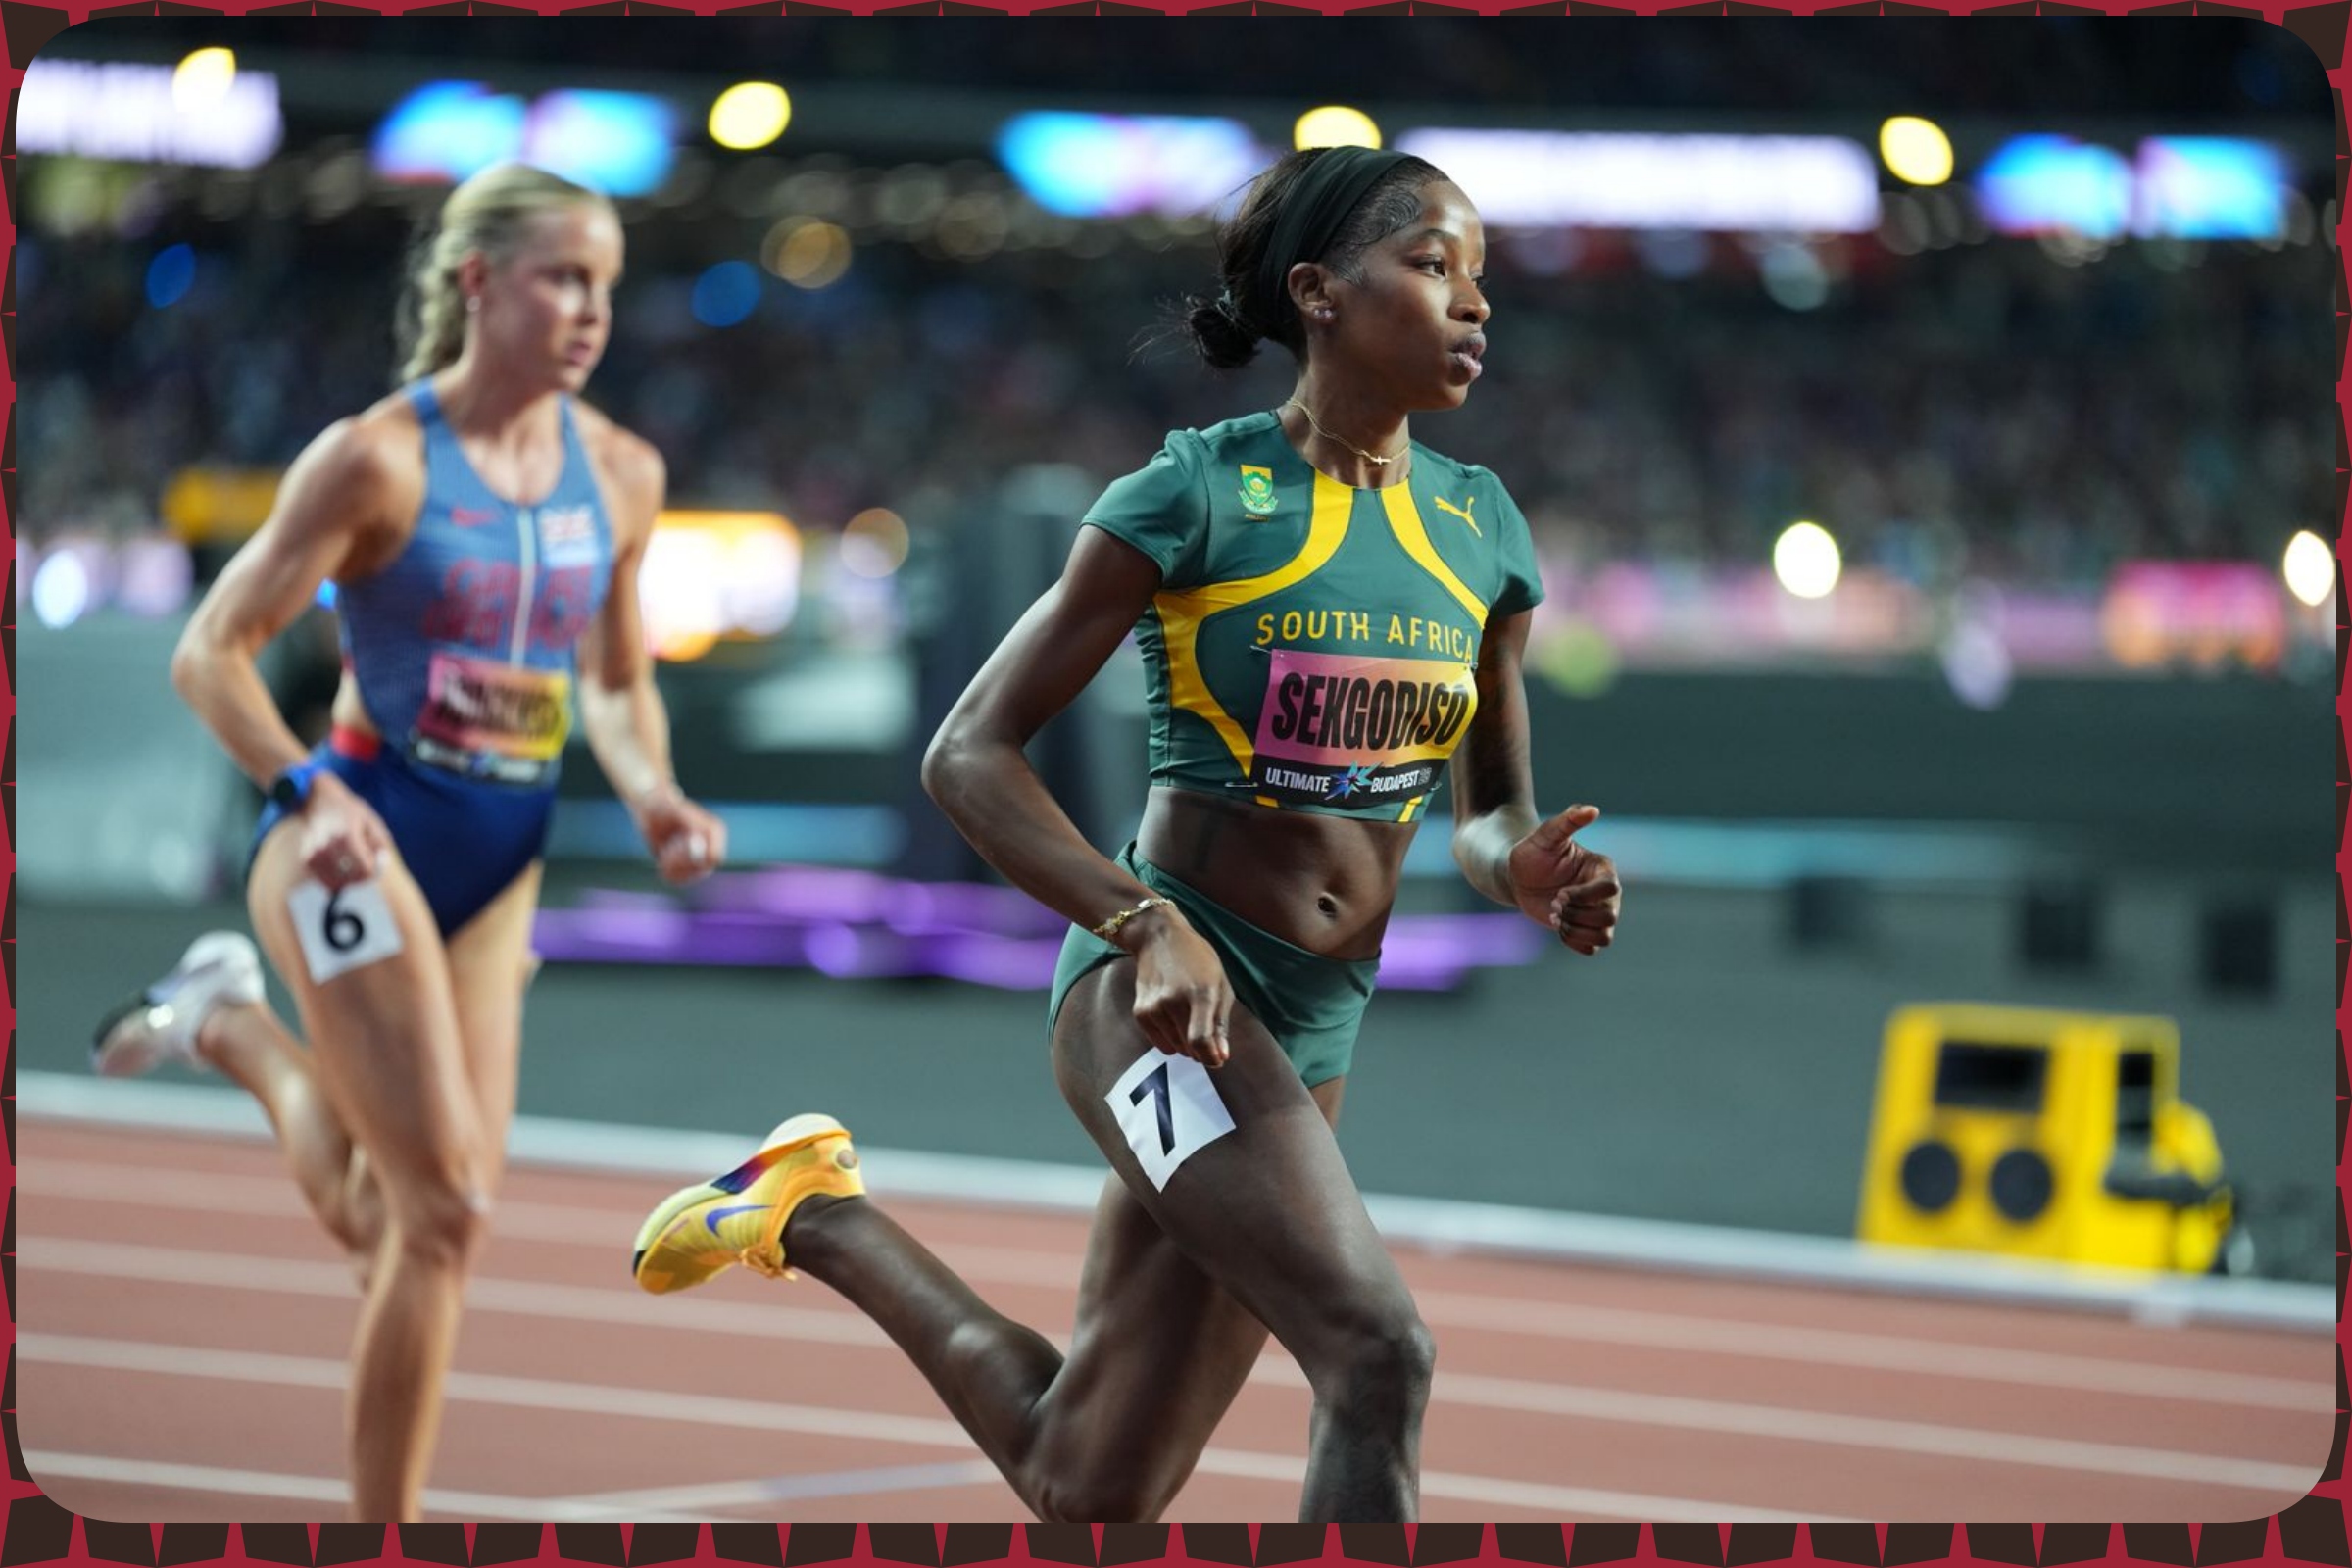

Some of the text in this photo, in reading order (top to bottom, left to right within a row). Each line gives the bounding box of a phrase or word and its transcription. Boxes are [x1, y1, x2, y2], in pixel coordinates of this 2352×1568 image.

[1256, 610, 1474, 662] SOUTH AFRICA
[1270, 671, 1470, 752] SEKGODISO
[1265, 766, 1331, 793] ULTIMATE
[1370, 769, 1420, 793] BUDAPEST
[322, 890, 366, 954] 6
[1128, 1061, 1176, 1157] 7
